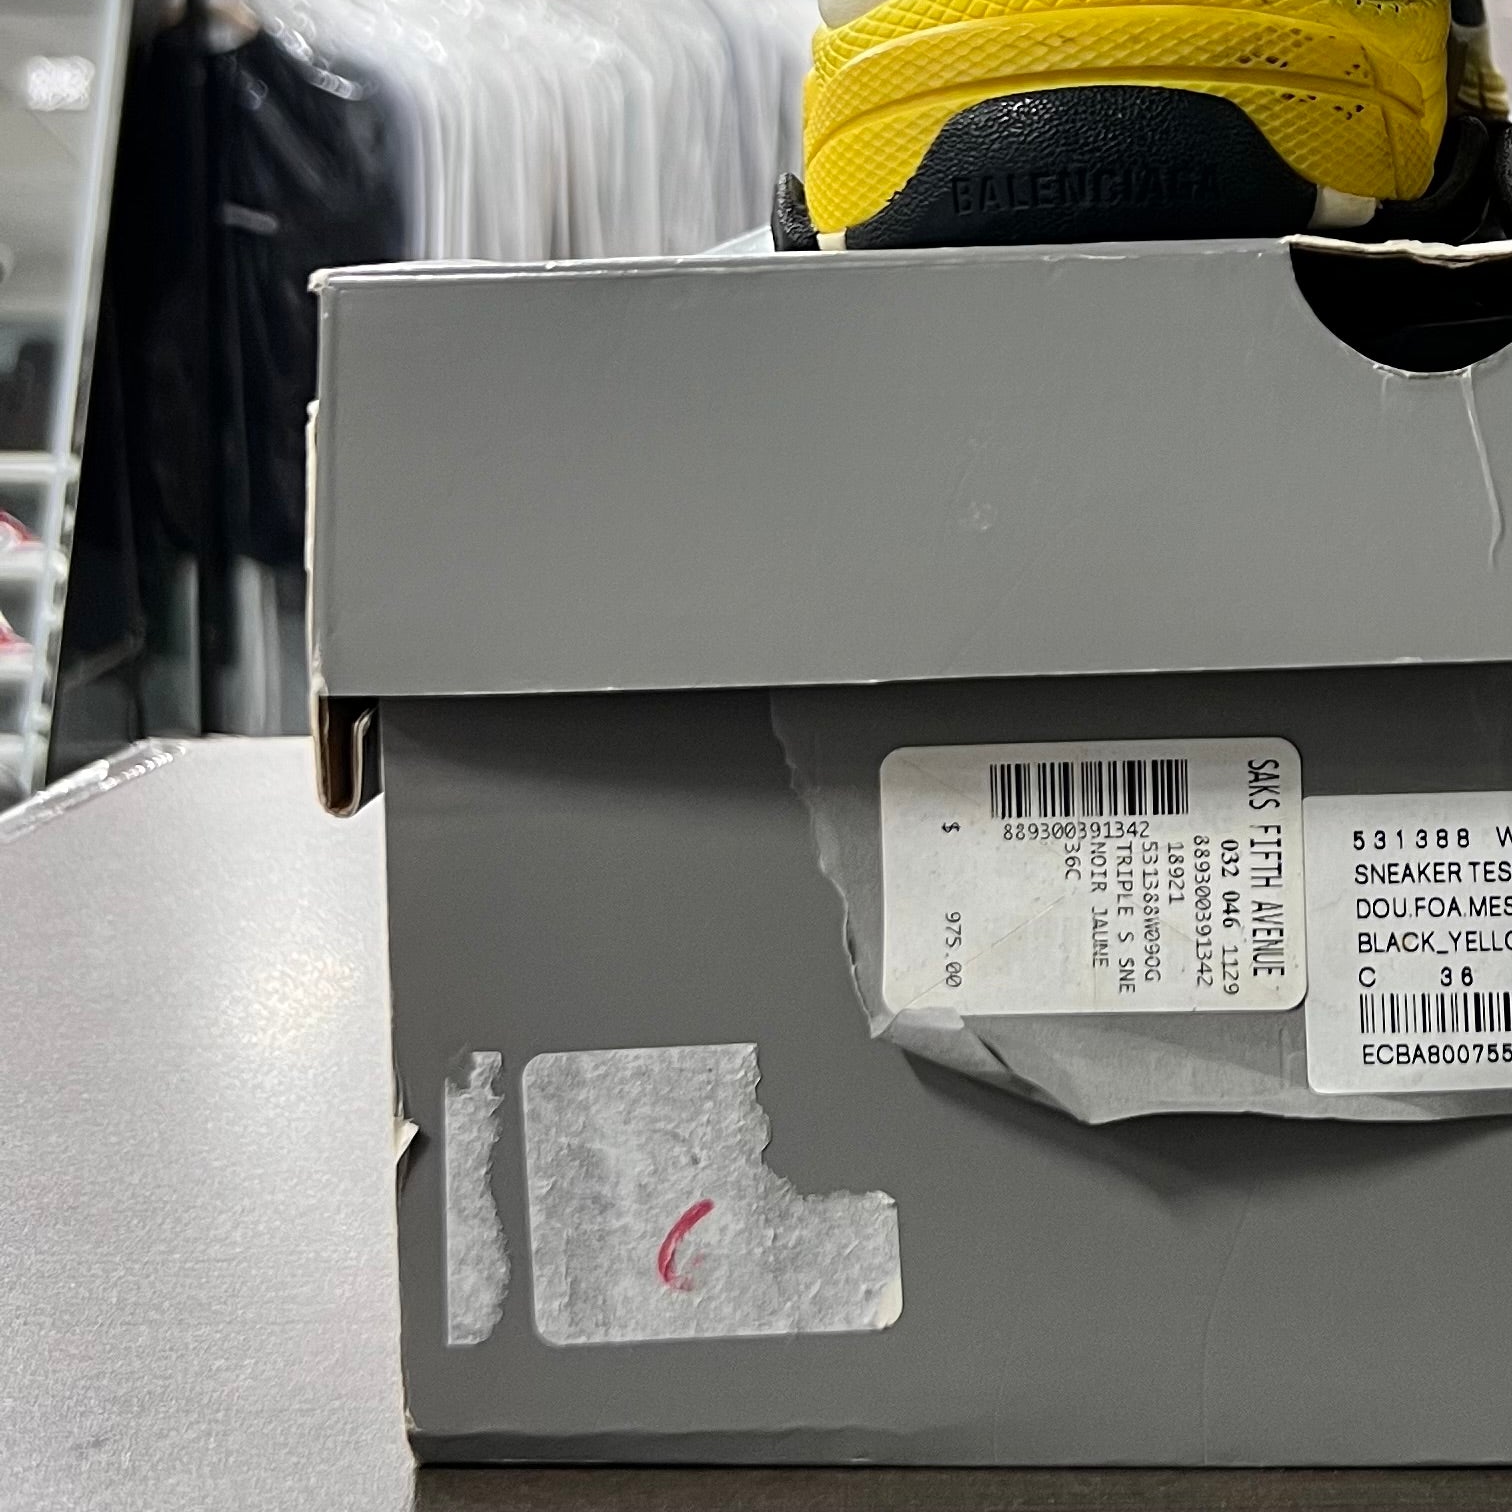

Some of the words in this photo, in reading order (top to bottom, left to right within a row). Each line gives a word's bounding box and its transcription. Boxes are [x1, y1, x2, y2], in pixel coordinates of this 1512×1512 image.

[1247, 758, 1281, 811] SAKS
[1003, 820, 1151, 841] 889300391342
[1249, 824, 1282, 889] FIFTH
[1353, 827, 1470, 851] 531388
[1064, 842, 1082, 881] 36C
[1089, 841, 1107, 893] NOIR
[1115, 841, 1134, 916] TRIPLE
[1167, 841, 1185, 904] 18921
[1220, 839, 1240, 878] 032
[1354, 861, 1462, 885] SNEAKER
[1193, 834, 1214, 987] 889300391342
[1221, 890, 1241, 929] 046
[944, 911, 963, 988] 975.00
[1091, 906, 1110, 968] JAUNE
[1117, 930, 1135, 943] S
[1251, 900, 1285, 977] AVENUE
[1118, 957, 1136, 994] SNE
[1222, 944, 1240, 996] 1129
[1358, 966, 1377, 988] C
[1440, 965, 1474, 987] 36
